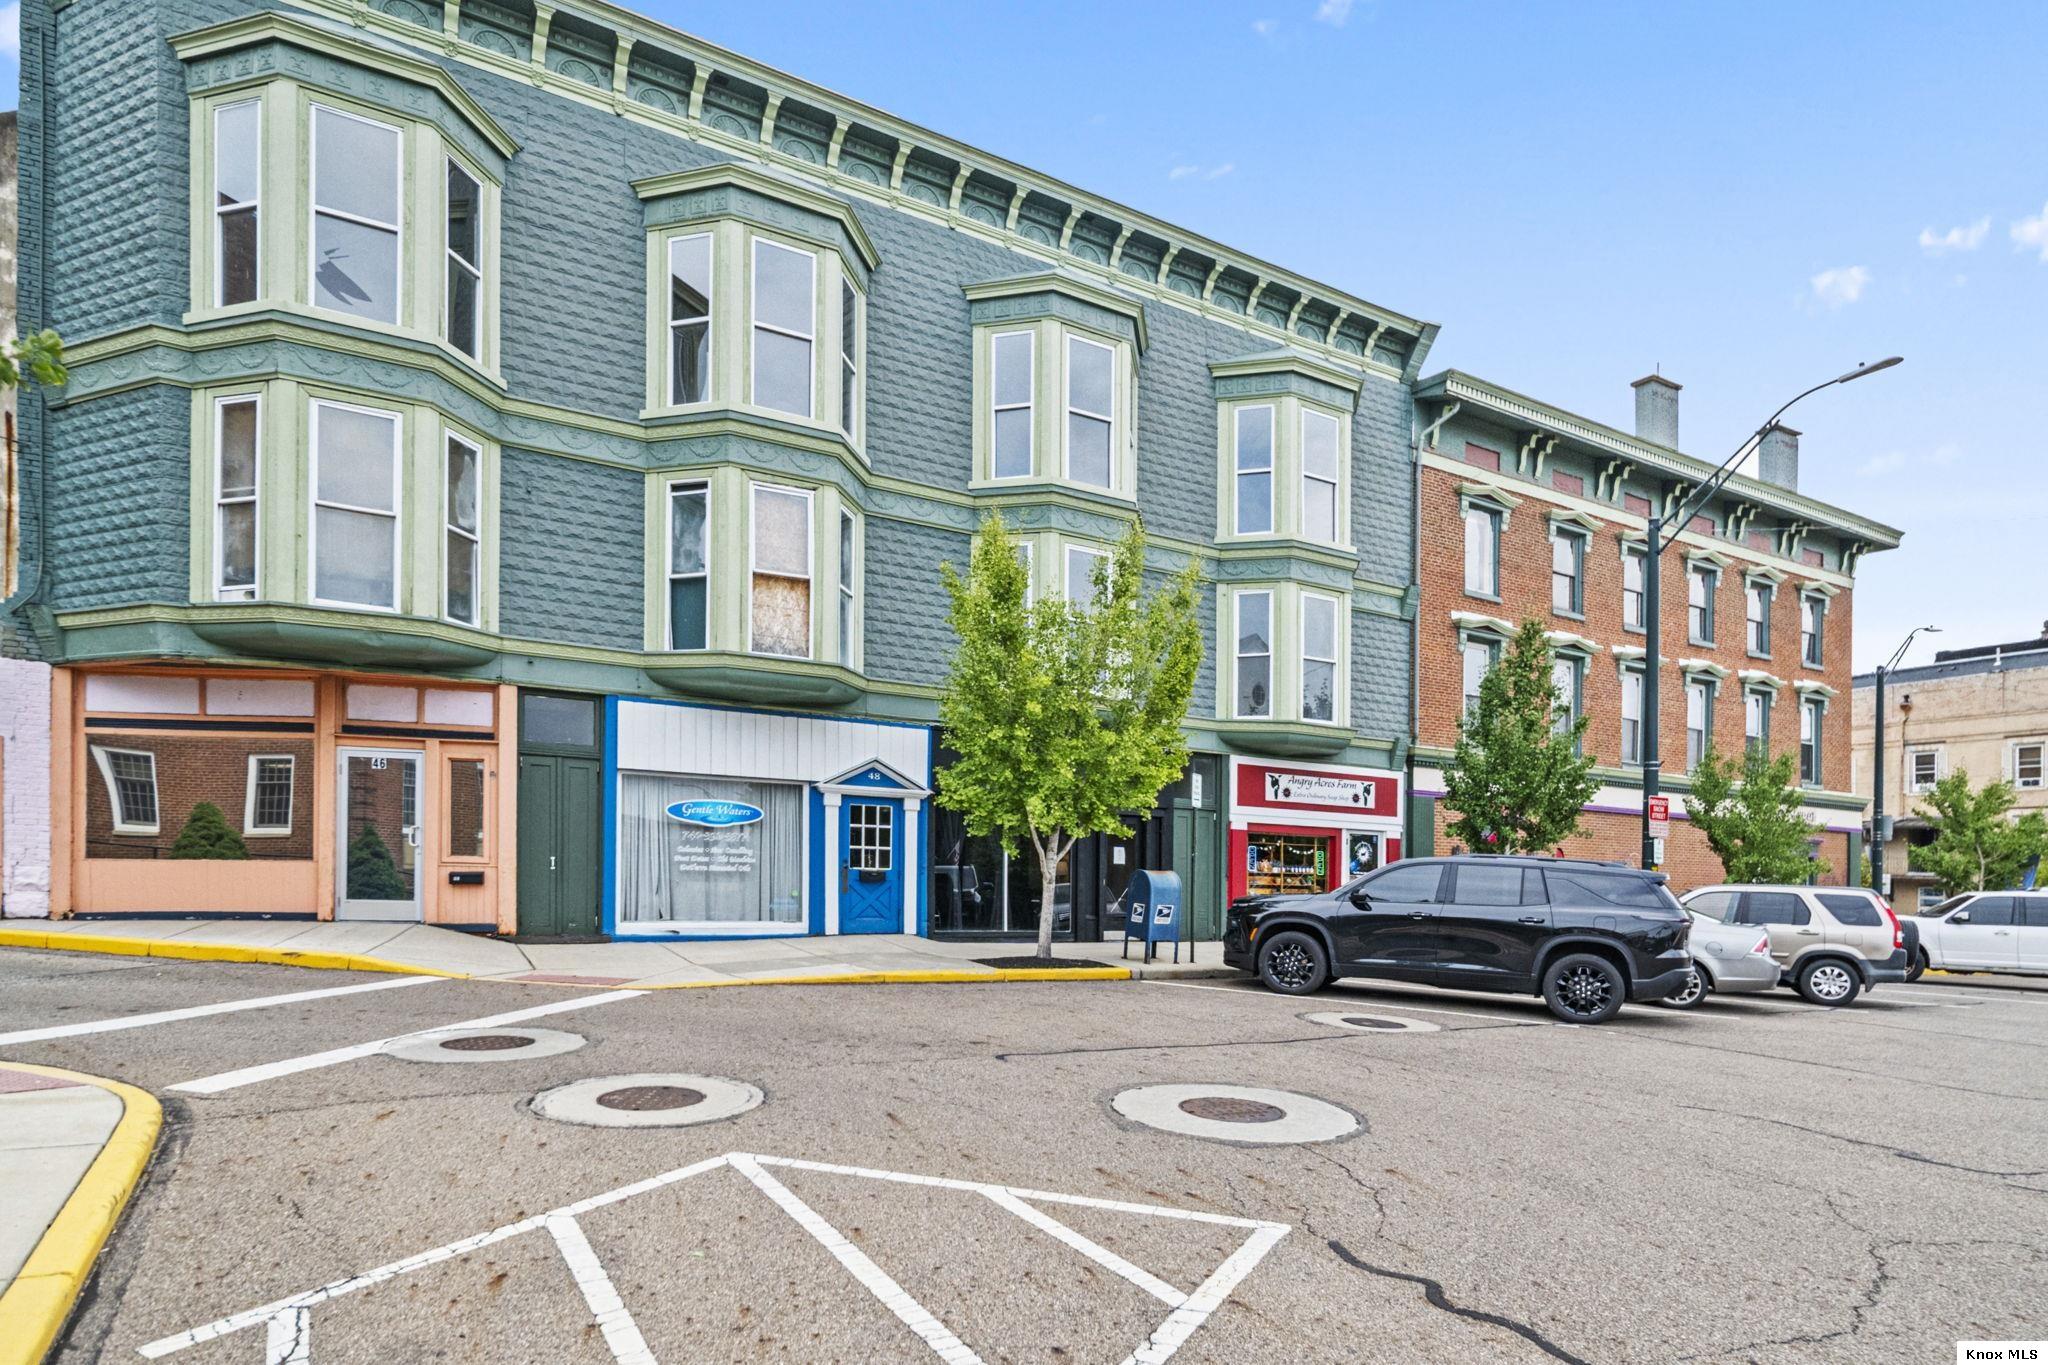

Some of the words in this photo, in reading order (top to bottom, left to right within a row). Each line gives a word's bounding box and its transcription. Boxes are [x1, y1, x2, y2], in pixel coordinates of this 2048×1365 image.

[373, 758, 386, 769] 46
[868, 772, 880, 781] 48
[1288, 775, 1313, 790] Angry
[1314, 777, 1335, 789] Acres
[1337, 779, 1357, 790] Farm
[682, 803, 714, 817] Gentle
[716, 804, 751, 816] Waters
